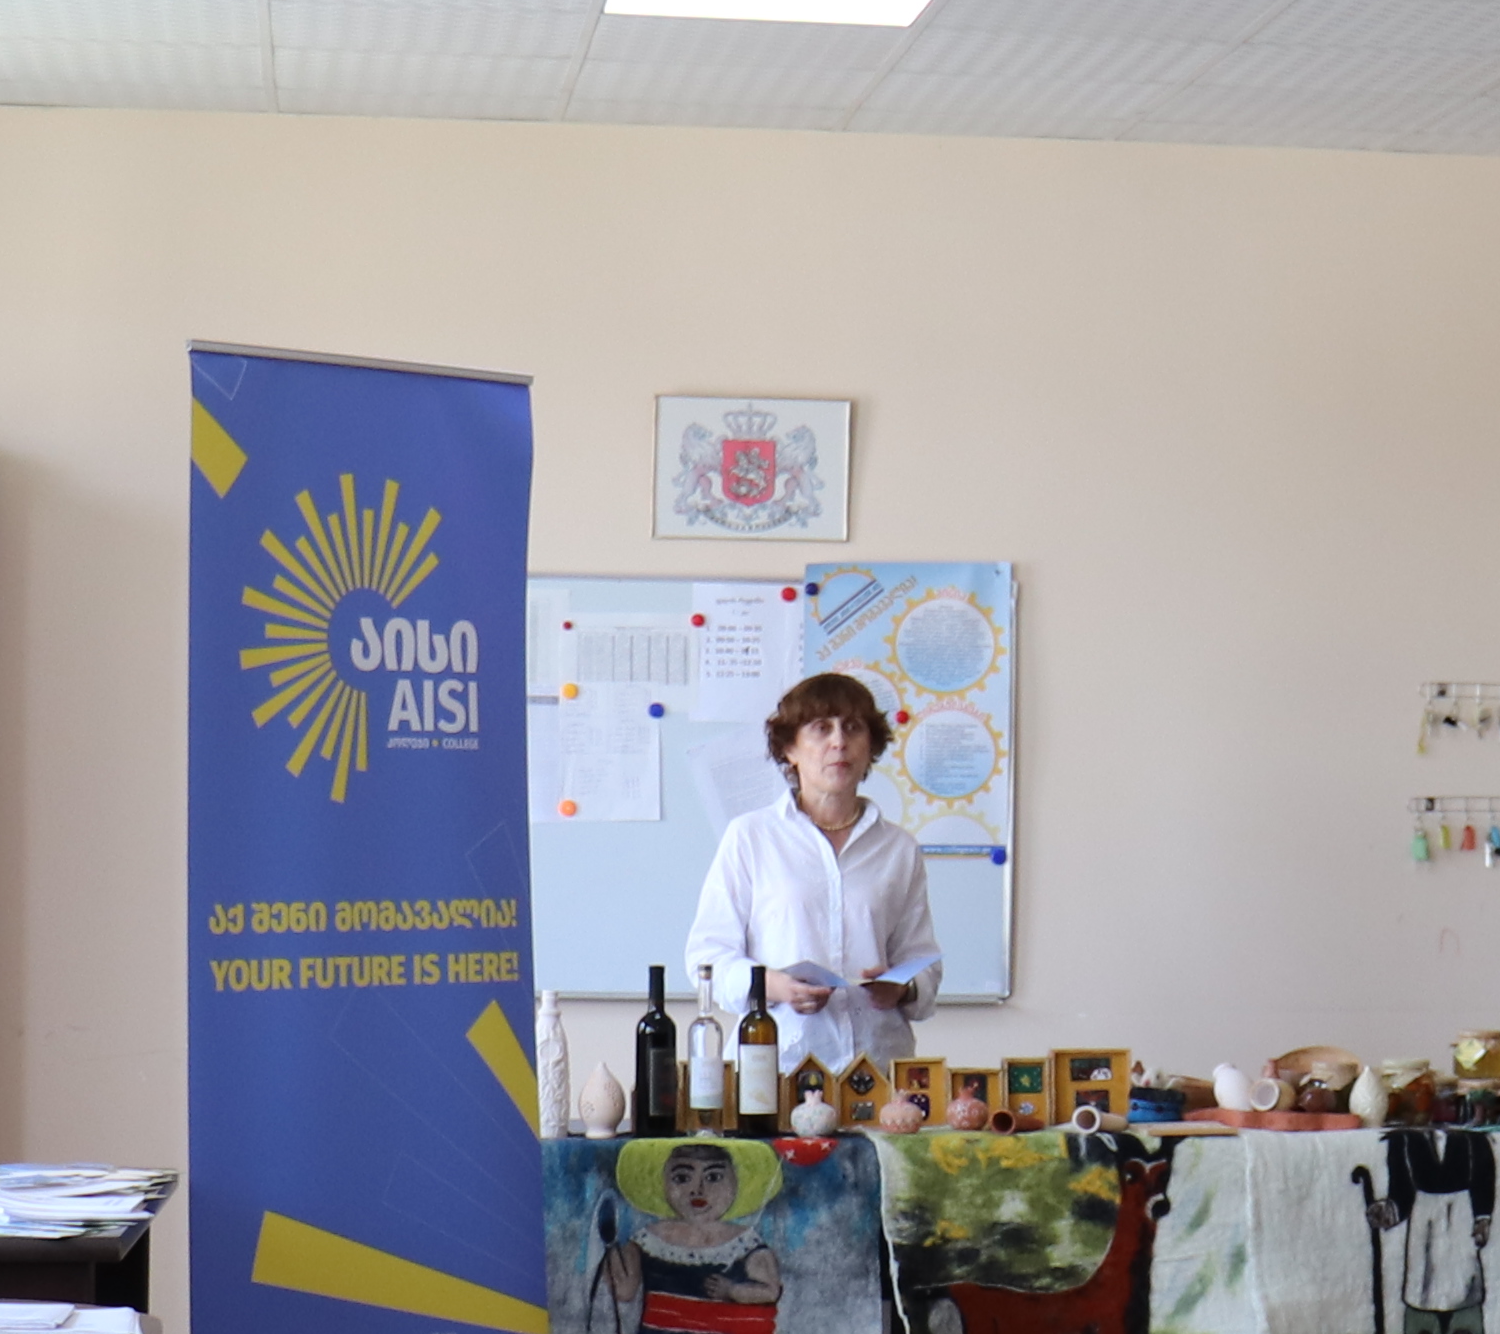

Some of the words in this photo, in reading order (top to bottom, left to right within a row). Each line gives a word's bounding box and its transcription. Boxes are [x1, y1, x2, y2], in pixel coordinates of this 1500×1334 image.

[350, 617, 479, 674] აისი
[388, 678, 479, 734] AISI
[209, 903, 245, 935] აქ
[251, 901, 328, 934] შენი
[334, 898, 518, 931] მომავალია!
[208, 958, 293, 992] YOUR
[299, 954, 407, 990] FUTURE
[413, 953, 441, 985] IS
[447, 951, 519, 984] HERE!
